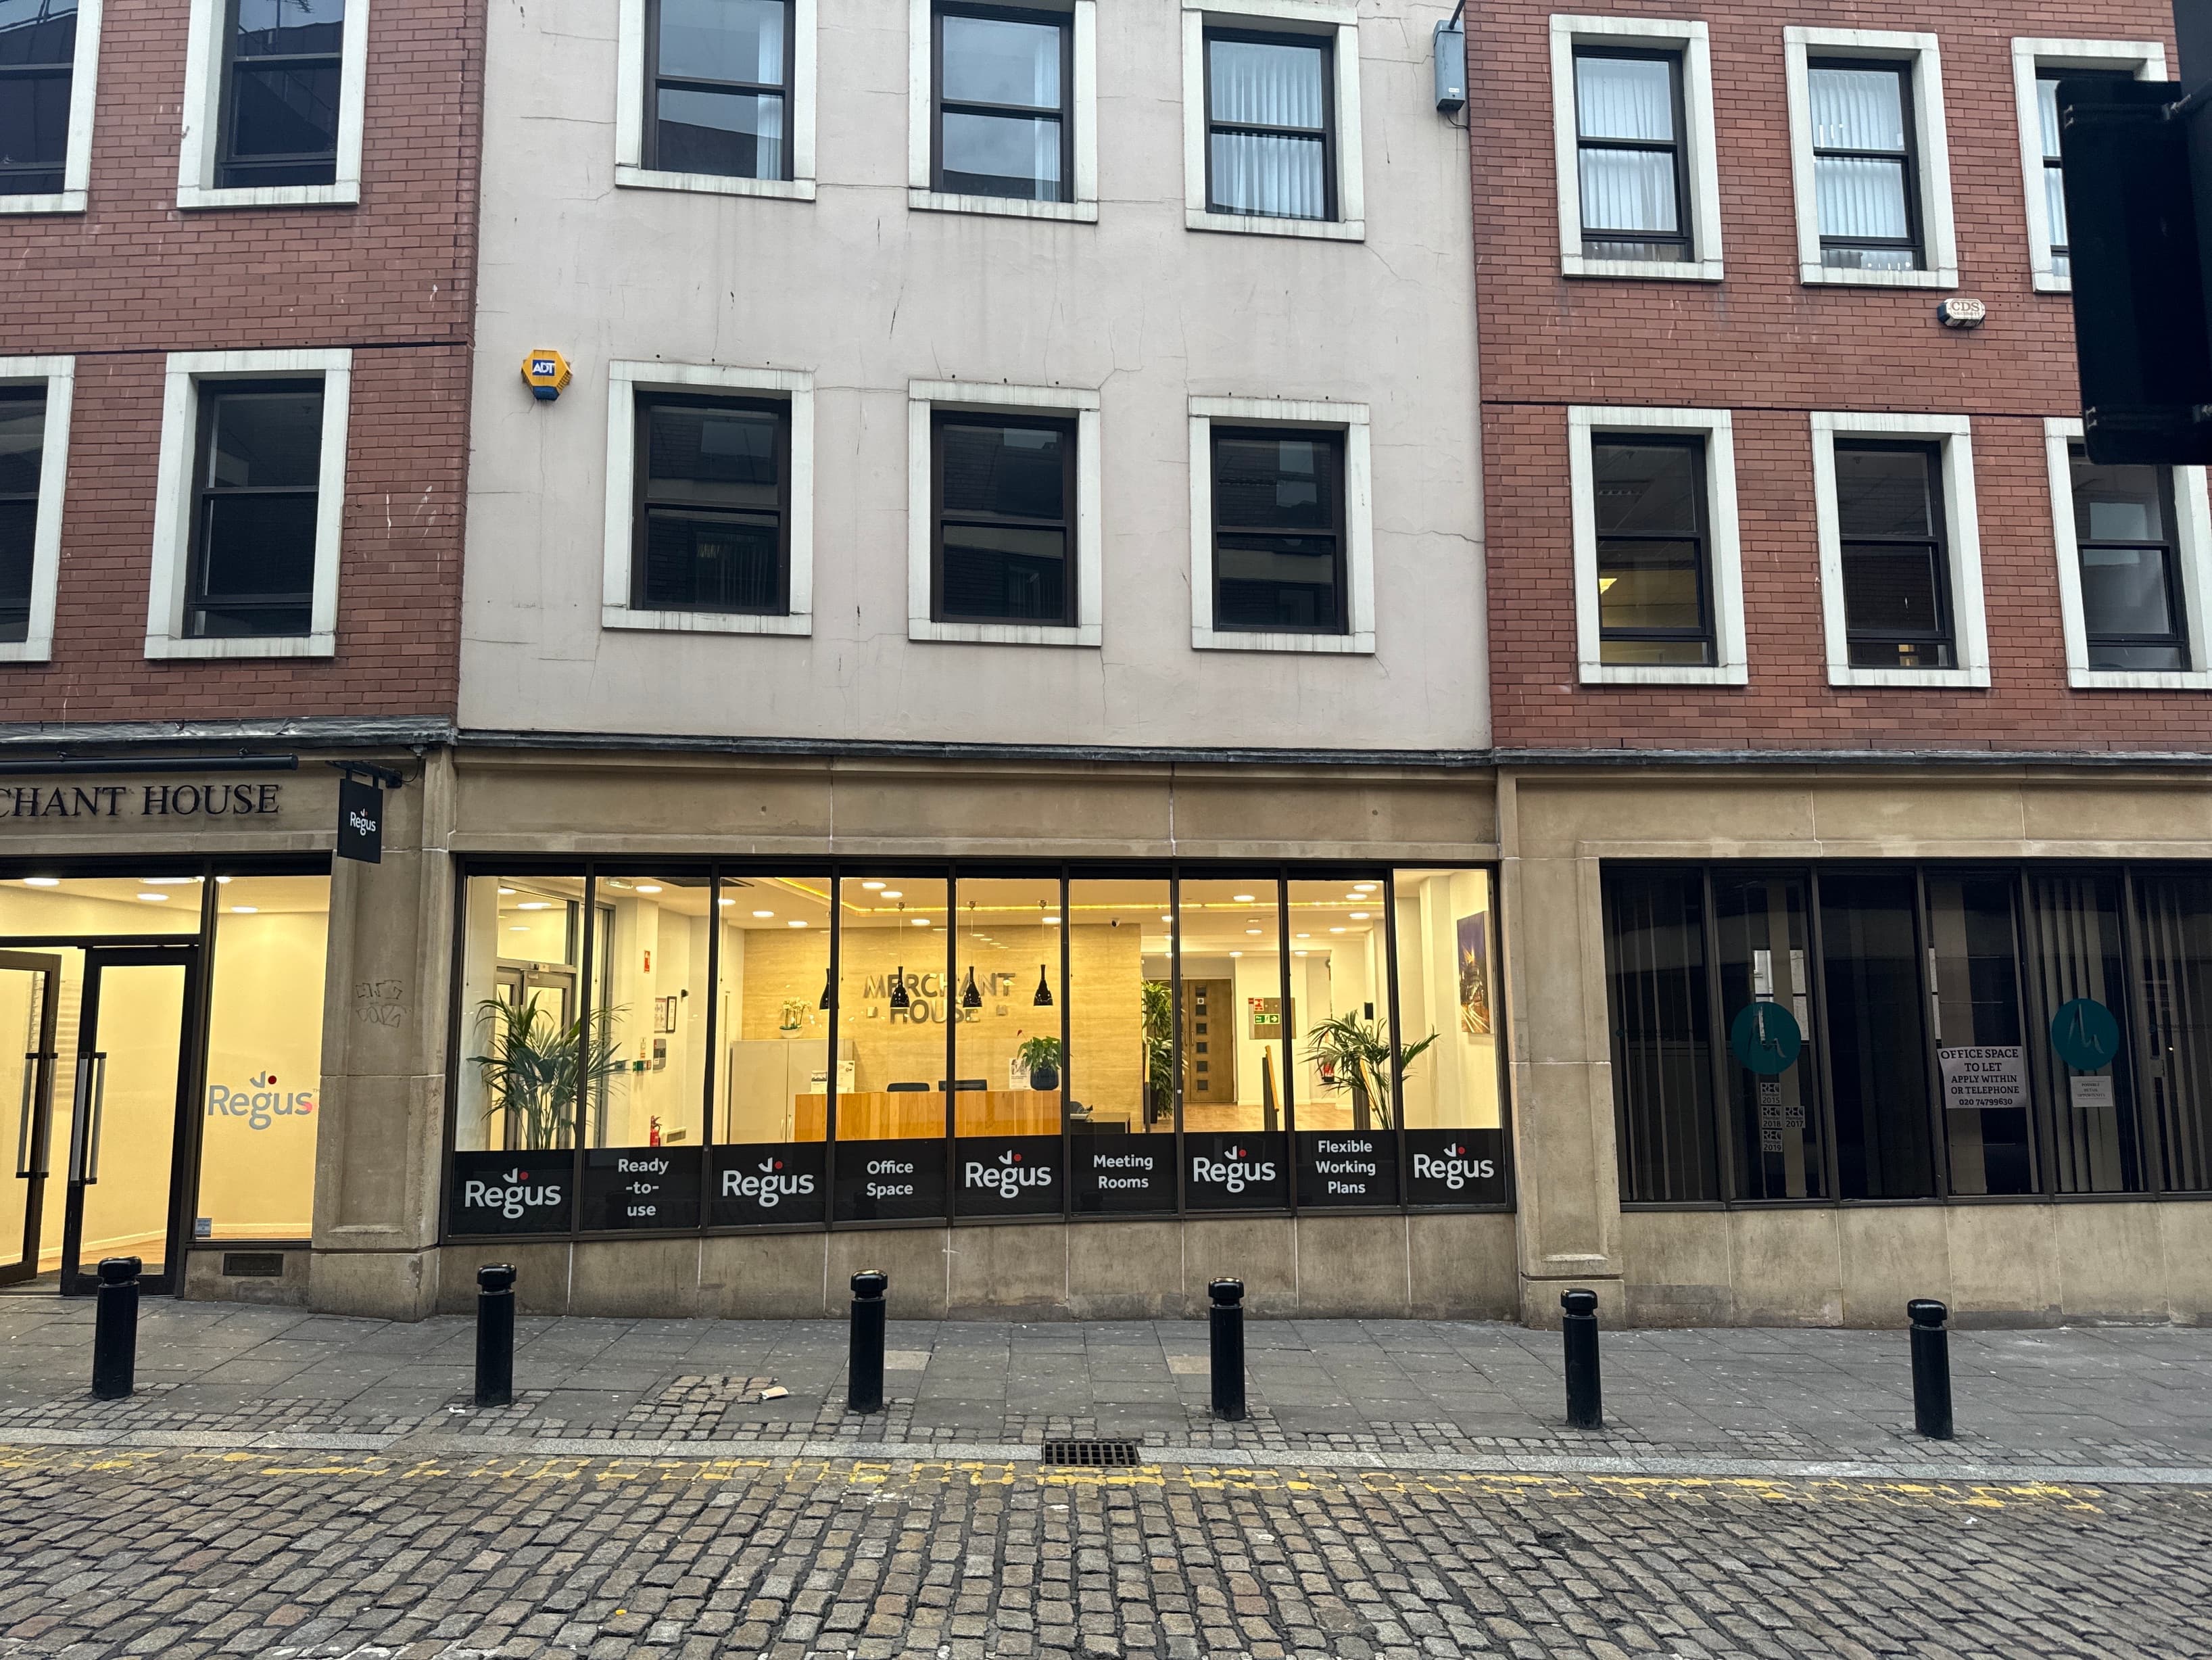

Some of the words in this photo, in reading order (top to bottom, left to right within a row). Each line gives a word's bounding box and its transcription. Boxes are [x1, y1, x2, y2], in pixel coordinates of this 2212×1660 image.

[1951, 301, 1980, 312] CDS
[533, 362, 556, 374] ADT
[141, 784, 280, 815] HOUSE
[350, 811, 377, 836] Regus
[1940, 1049, 1983, 1060] OFFICE
[1985, 1049, 2019, 1058] SPACE
[1965, 1062, 1979, 1072] TO
[1982, 1062, 2002, 1072] LET
[1951, 1075, 1979, 1083] APPLY
[1981, 1074, 2017, 1083] WITHIN
[1762, 1083, 1779, 1093] REC
[1965, 1086, 2019, 1094] TELEPHONE
[208, 1085, 313, 1130] Regus
[1975, 1098, 2013, 1106] 74799630
[1763, 1107, 1780, 1116] REC
[1785, 1107, 1804, 1116] REC
[1764, 1131, 1781, 1140] REC
[1318, 1139, 1372, 1153] Flexible
[618, 1158, 669, 1175] Ready
[867, 1160, 913, 1174] Office
[1093, 1154, 1153, 1170] Meeting
[1316, 1160, 1376, 1176] Working
[1193, 1157, 1276, 1193] Regus
[1414, 1154, 1494, 1189] Regus
[965, 1162, 1052, 1198] Regus
[1099, 1176, 1149, 1189] Rooms
[626, 1181, 659, 1194] -to-
[723, 1169, 814, 1208] Regus
[867, 1182, 913, 1199] Space
[1328, 1181, 1366, 1193] Plans
[465, 1179, 561, 1218] Regus
[627, 1206, 656, 1216] use
